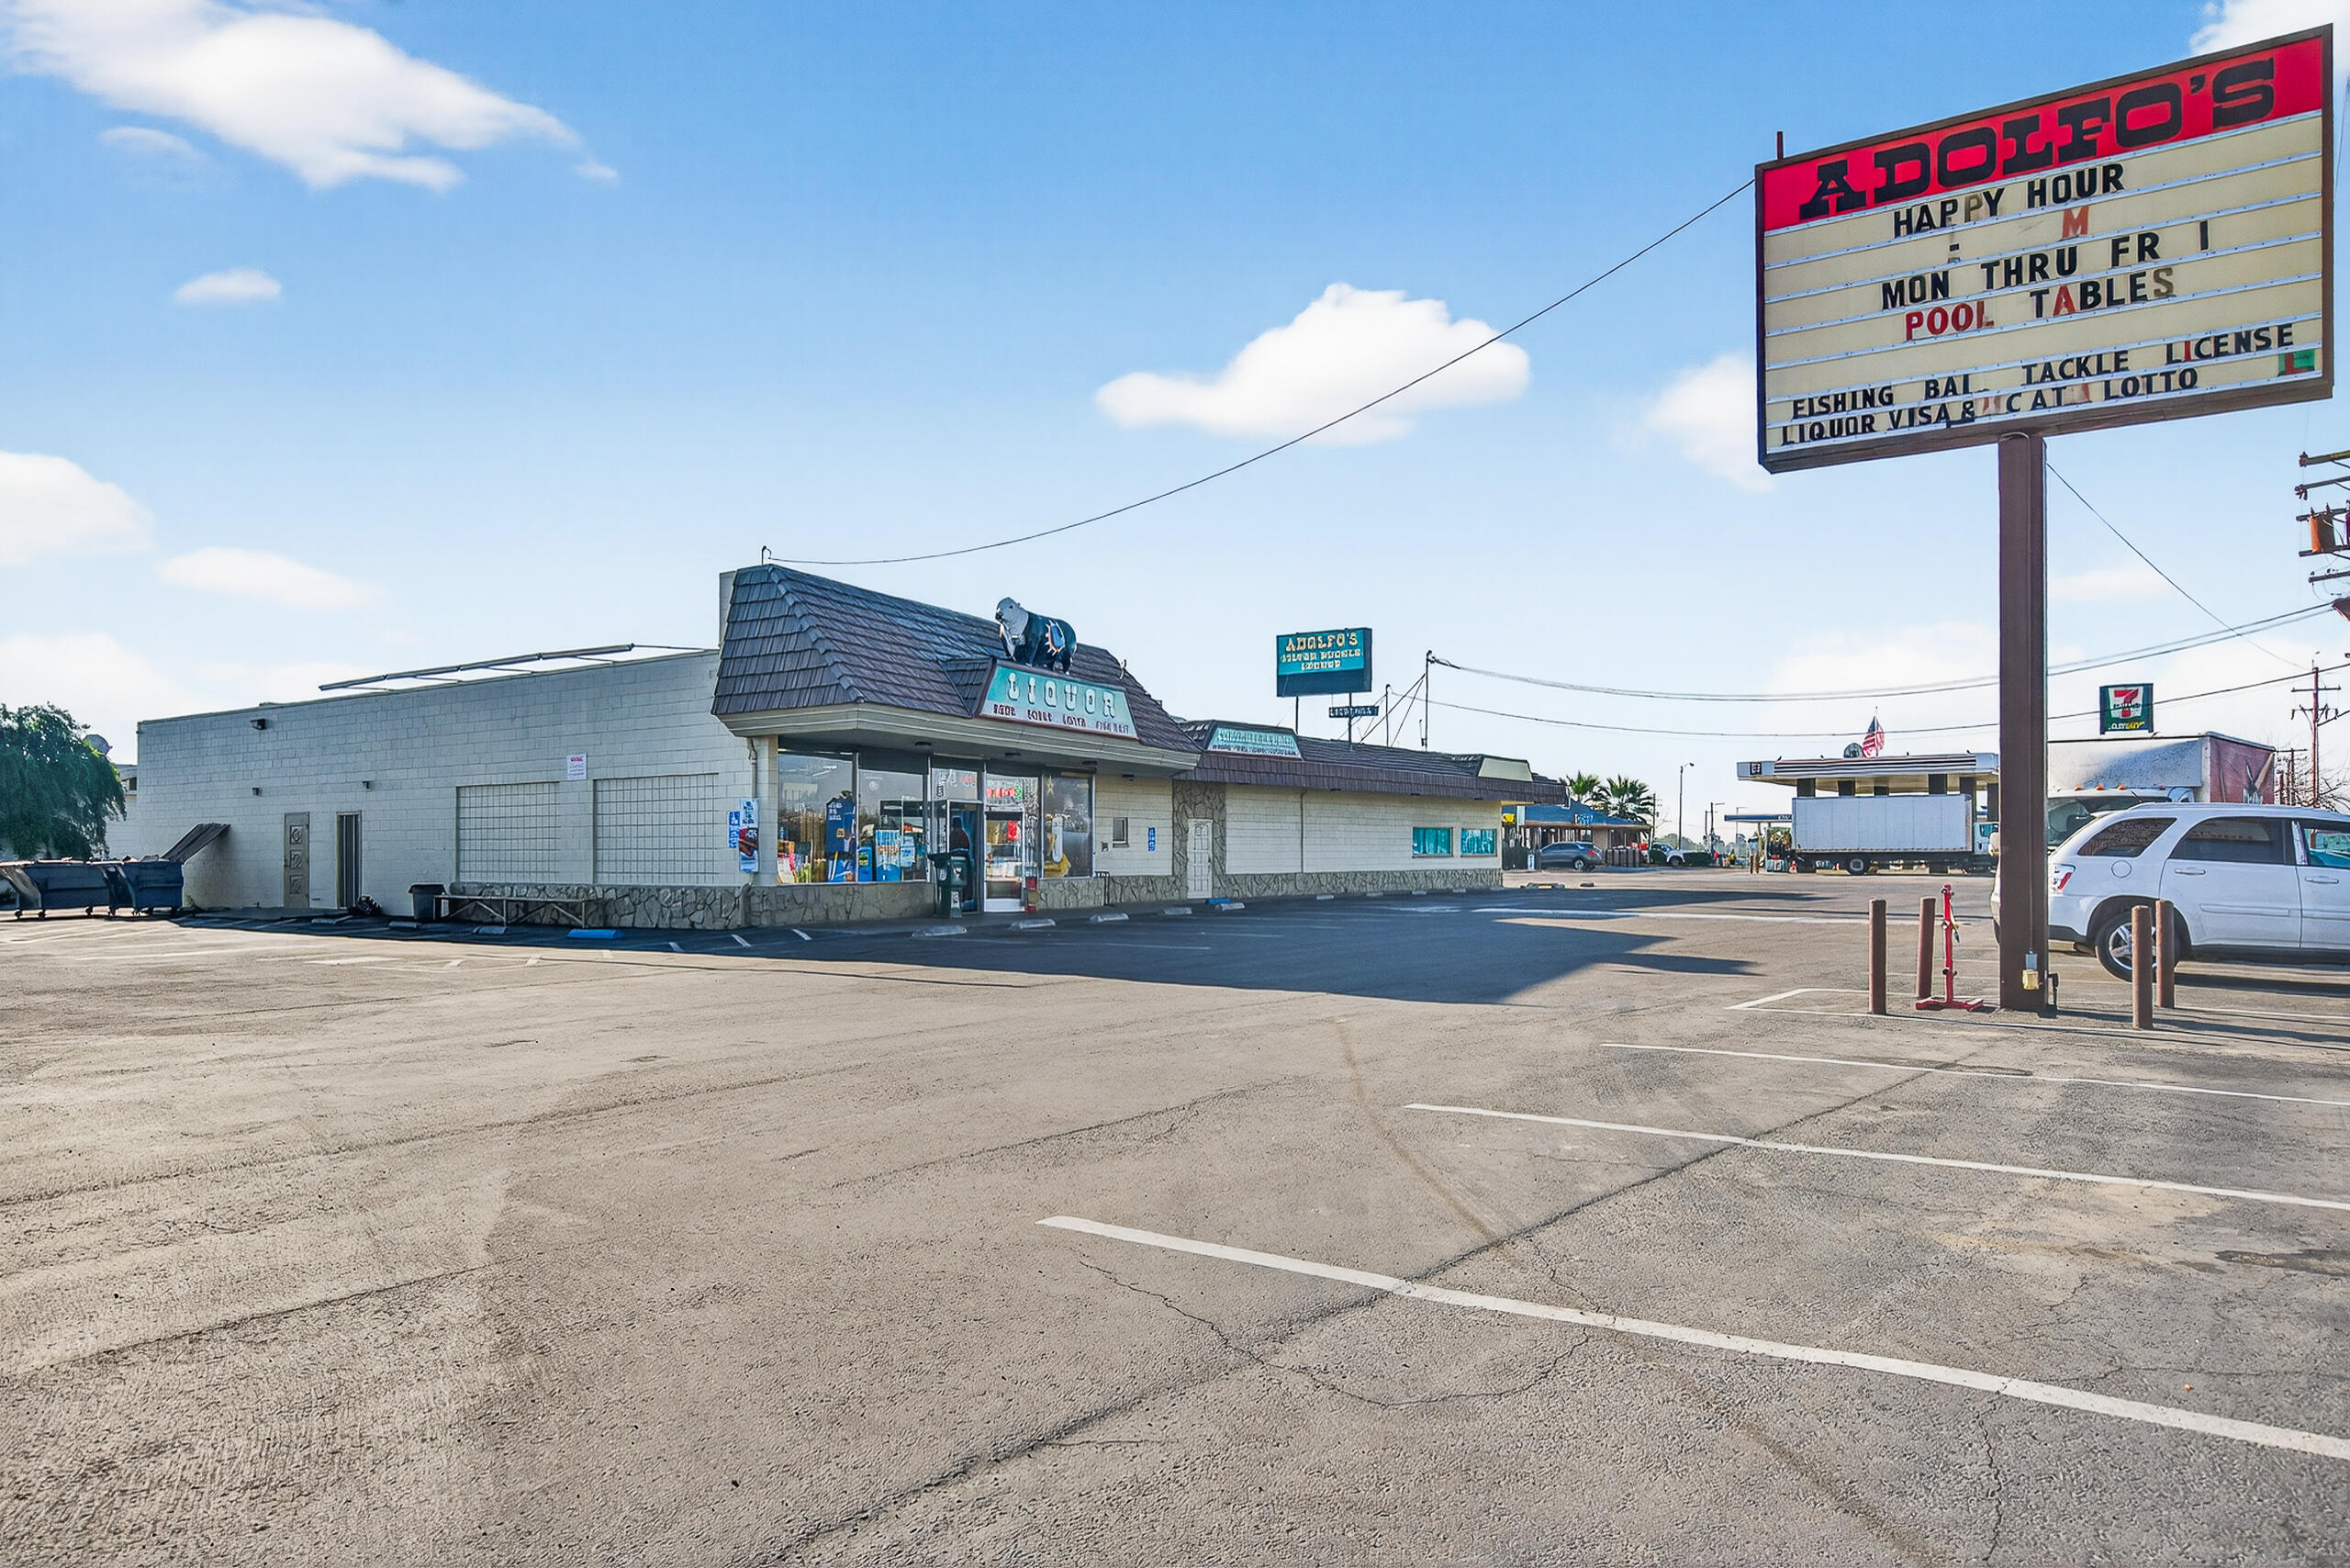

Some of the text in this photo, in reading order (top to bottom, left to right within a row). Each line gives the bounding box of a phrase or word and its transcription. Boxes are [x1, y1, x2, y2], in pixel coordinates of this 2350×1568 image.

[1799, 57, 2275, 220] ADOLFO'S
[1893, 162, 2125, 239] HAPPY HOUR
[1882, 270, 1950, 310] MON
[1980, 245, 2078, 290] THRU
[1905, 267, 2175, 342] POOL TABLES
[1781, 414, 1875, 446] LIQUOR
[1888, 403, 1952, 431] VISA
[2104, 368, 2198, 401] LOTTO
[1792, 386, 1895, 420] FISHING
[2021, 350, 2129, 386] TACKLE
[2166, 323, 2294, 364] LICENSE
[1286, 633, 1358, 651] ADOLFO'S
[1008, 672, 1116, 719] LIQUOR
